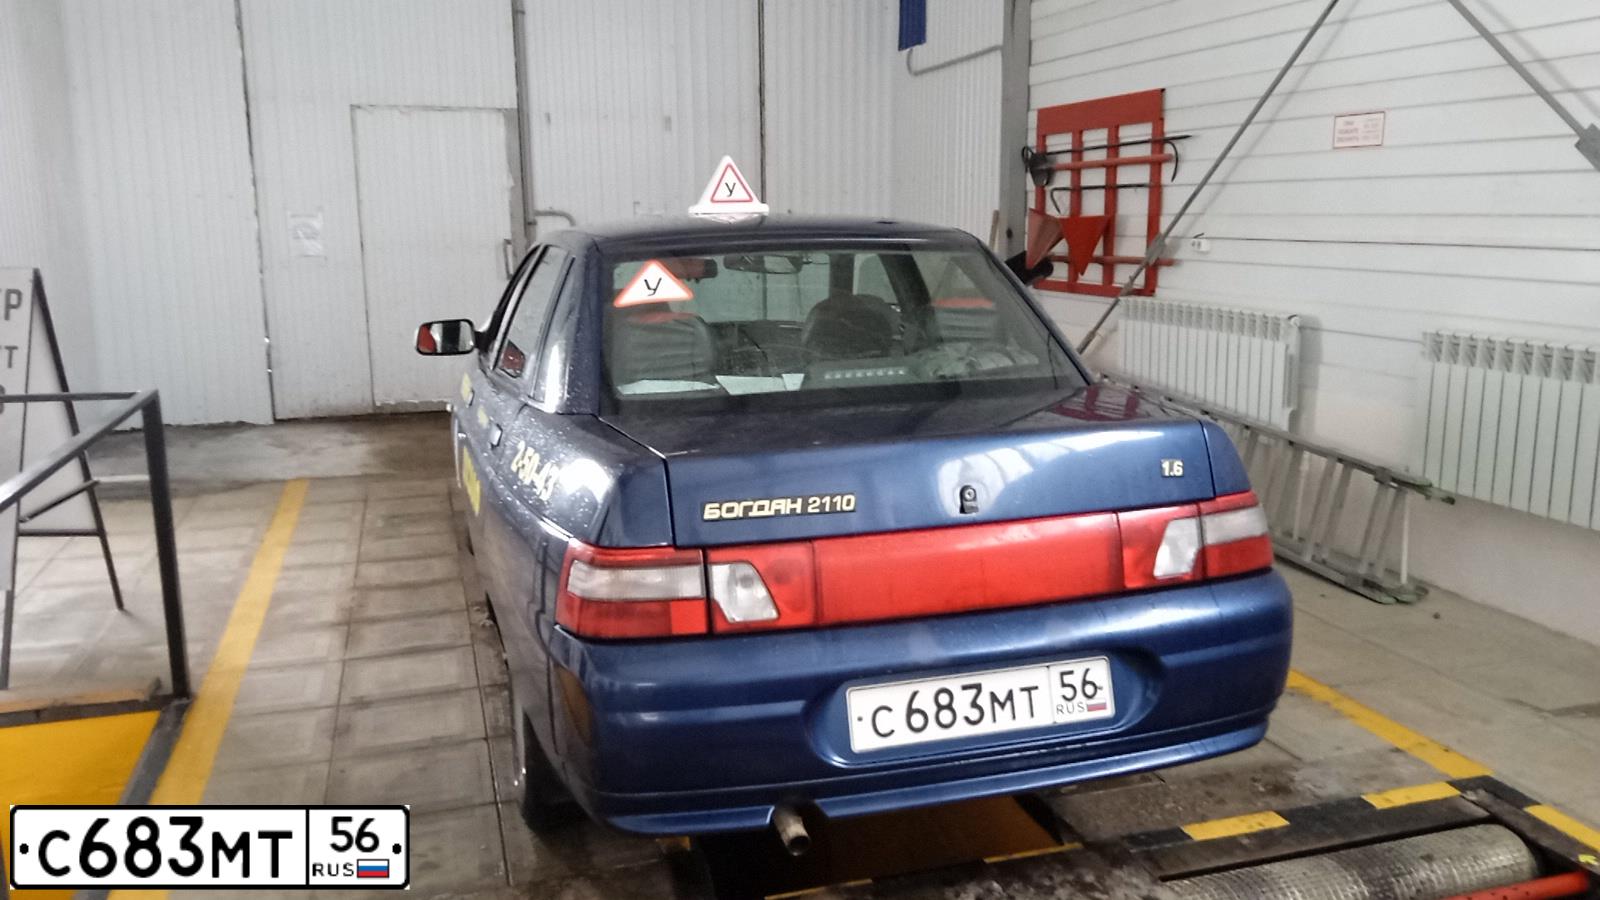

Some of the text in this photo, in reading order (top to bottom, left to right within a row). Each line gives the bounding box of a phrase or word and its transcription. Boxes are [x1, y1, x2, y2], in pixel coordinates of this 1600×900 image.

[1161, 460, 1184, 477] 1.6
[703, 494, 856, 520] БОГДАН 2110
[871, 668, 1098, 738] С683МТ 56
[1056, 702, 1086, 716] RUS
